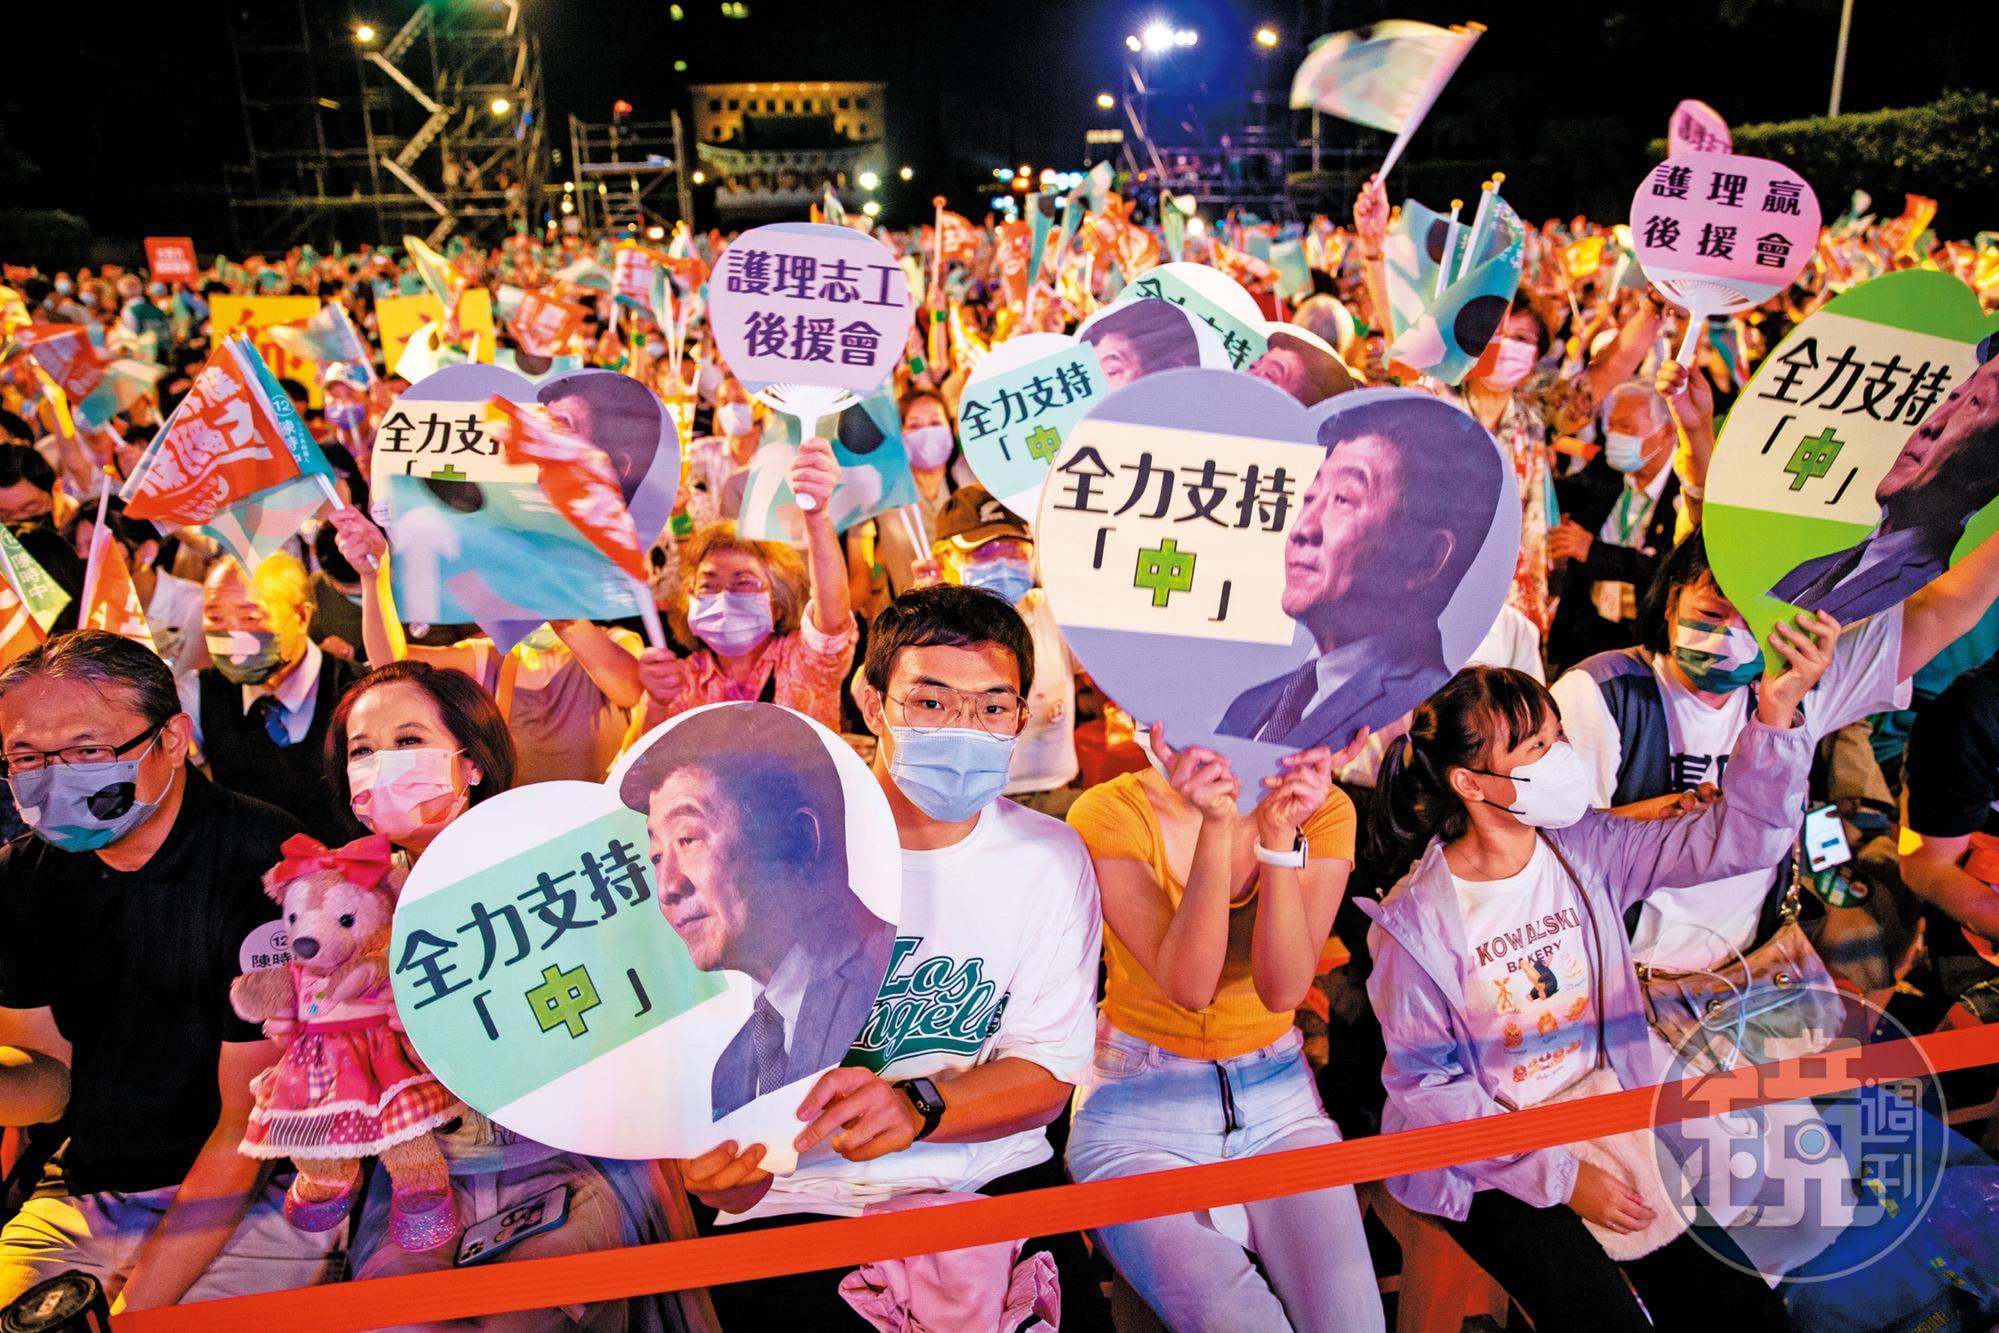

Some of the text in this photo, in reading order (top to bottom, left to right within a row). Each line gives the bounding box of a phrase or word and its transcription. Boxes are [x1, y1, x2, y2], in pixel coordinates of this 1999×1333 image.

[1652, 164, 1804, 216] 護理贏
[1643, 215, 1793, 269] 後援會
[727, 248, 905, 308] 護理志工
[743, 310, 882, 367] 後援會
[961, 361, 1093, 441] 全力支持
[1757, 337, 1952, 426] 全力支持
[380, 412, 500, 456] 全力支
[1053, 446, 1296, 532] 全力支持
[395, 839, 651, 1010] 全力支持
[1476, 907, 1580, 967] KOWALSKI
